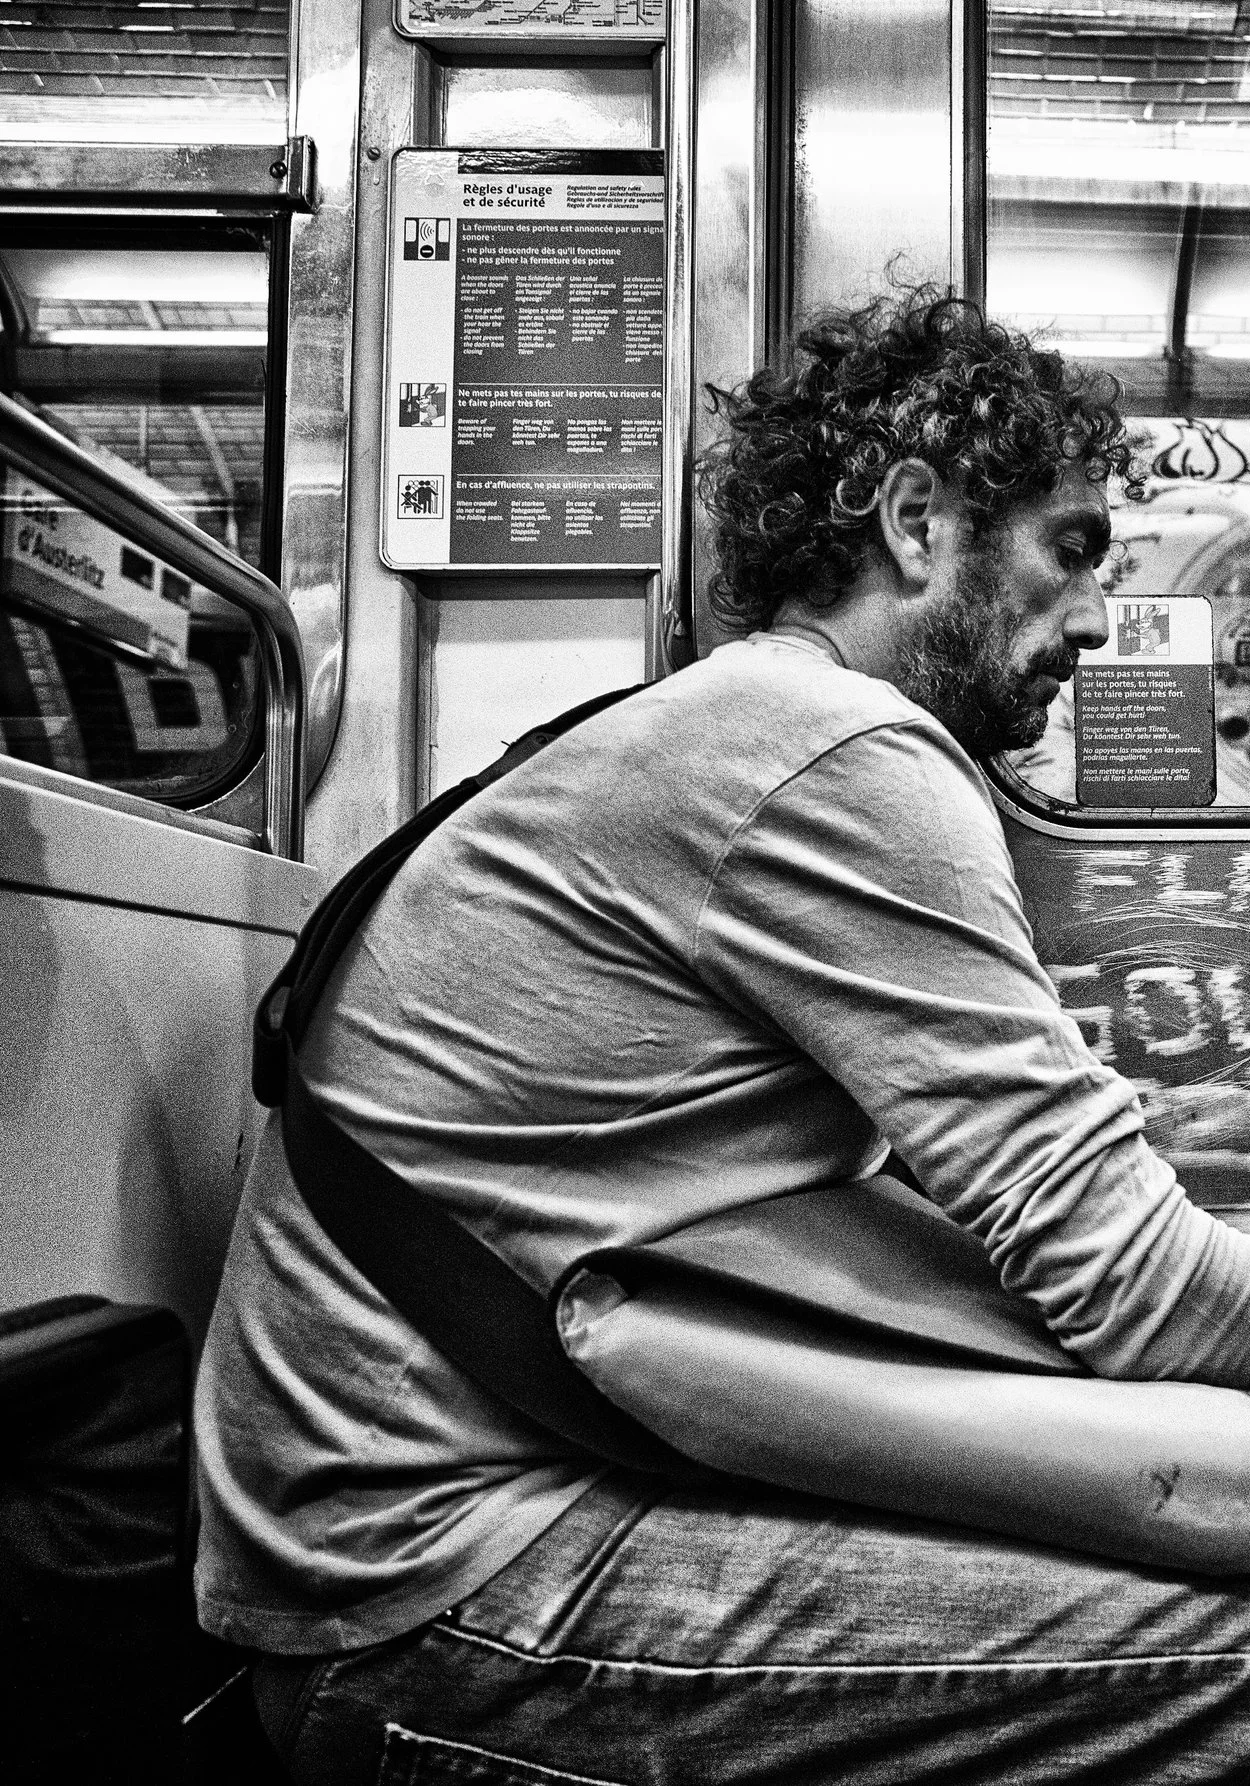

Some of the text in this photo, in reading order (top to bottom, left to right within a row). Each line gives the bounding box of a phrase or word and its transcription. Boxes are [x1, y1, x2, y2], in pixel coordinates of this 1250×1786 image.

[464, 184, 552, 197] Règles d'usage
[463, 197, 545, 207] et de sécurité
[516, 224, 530, 232] des
[532, 225, 559, 233] portes
[480, 247, 496, 255] plus
[557, 248, 575, 256] qu'il
[495, 257, 518, 265] gêner
[588, 258, 614, 266] portes
[579, 391, 608, 399] portes,
[620, 390, 649, 399] risques
[651, 390, 662, 398] de
[490, 400, 516, 408] pincer
[485, 481, 533, 489] d'affluence,
[547, 483, 562, 491] pas
[607, 482, 655, 491] strapontins.
[1109, 681, 1136, 689] portes,
[1149, 680, 1177, 689] risques
[1082, 689, 1092, 697] de
[1105, 689, 1123, 697] faire
[1125, 689, 1149, 699] pincer
[1151, 689, 1167, 697] très
[1168, 689, 1185, 697] fort.
[1083, 705, 1099, 713] Keep
